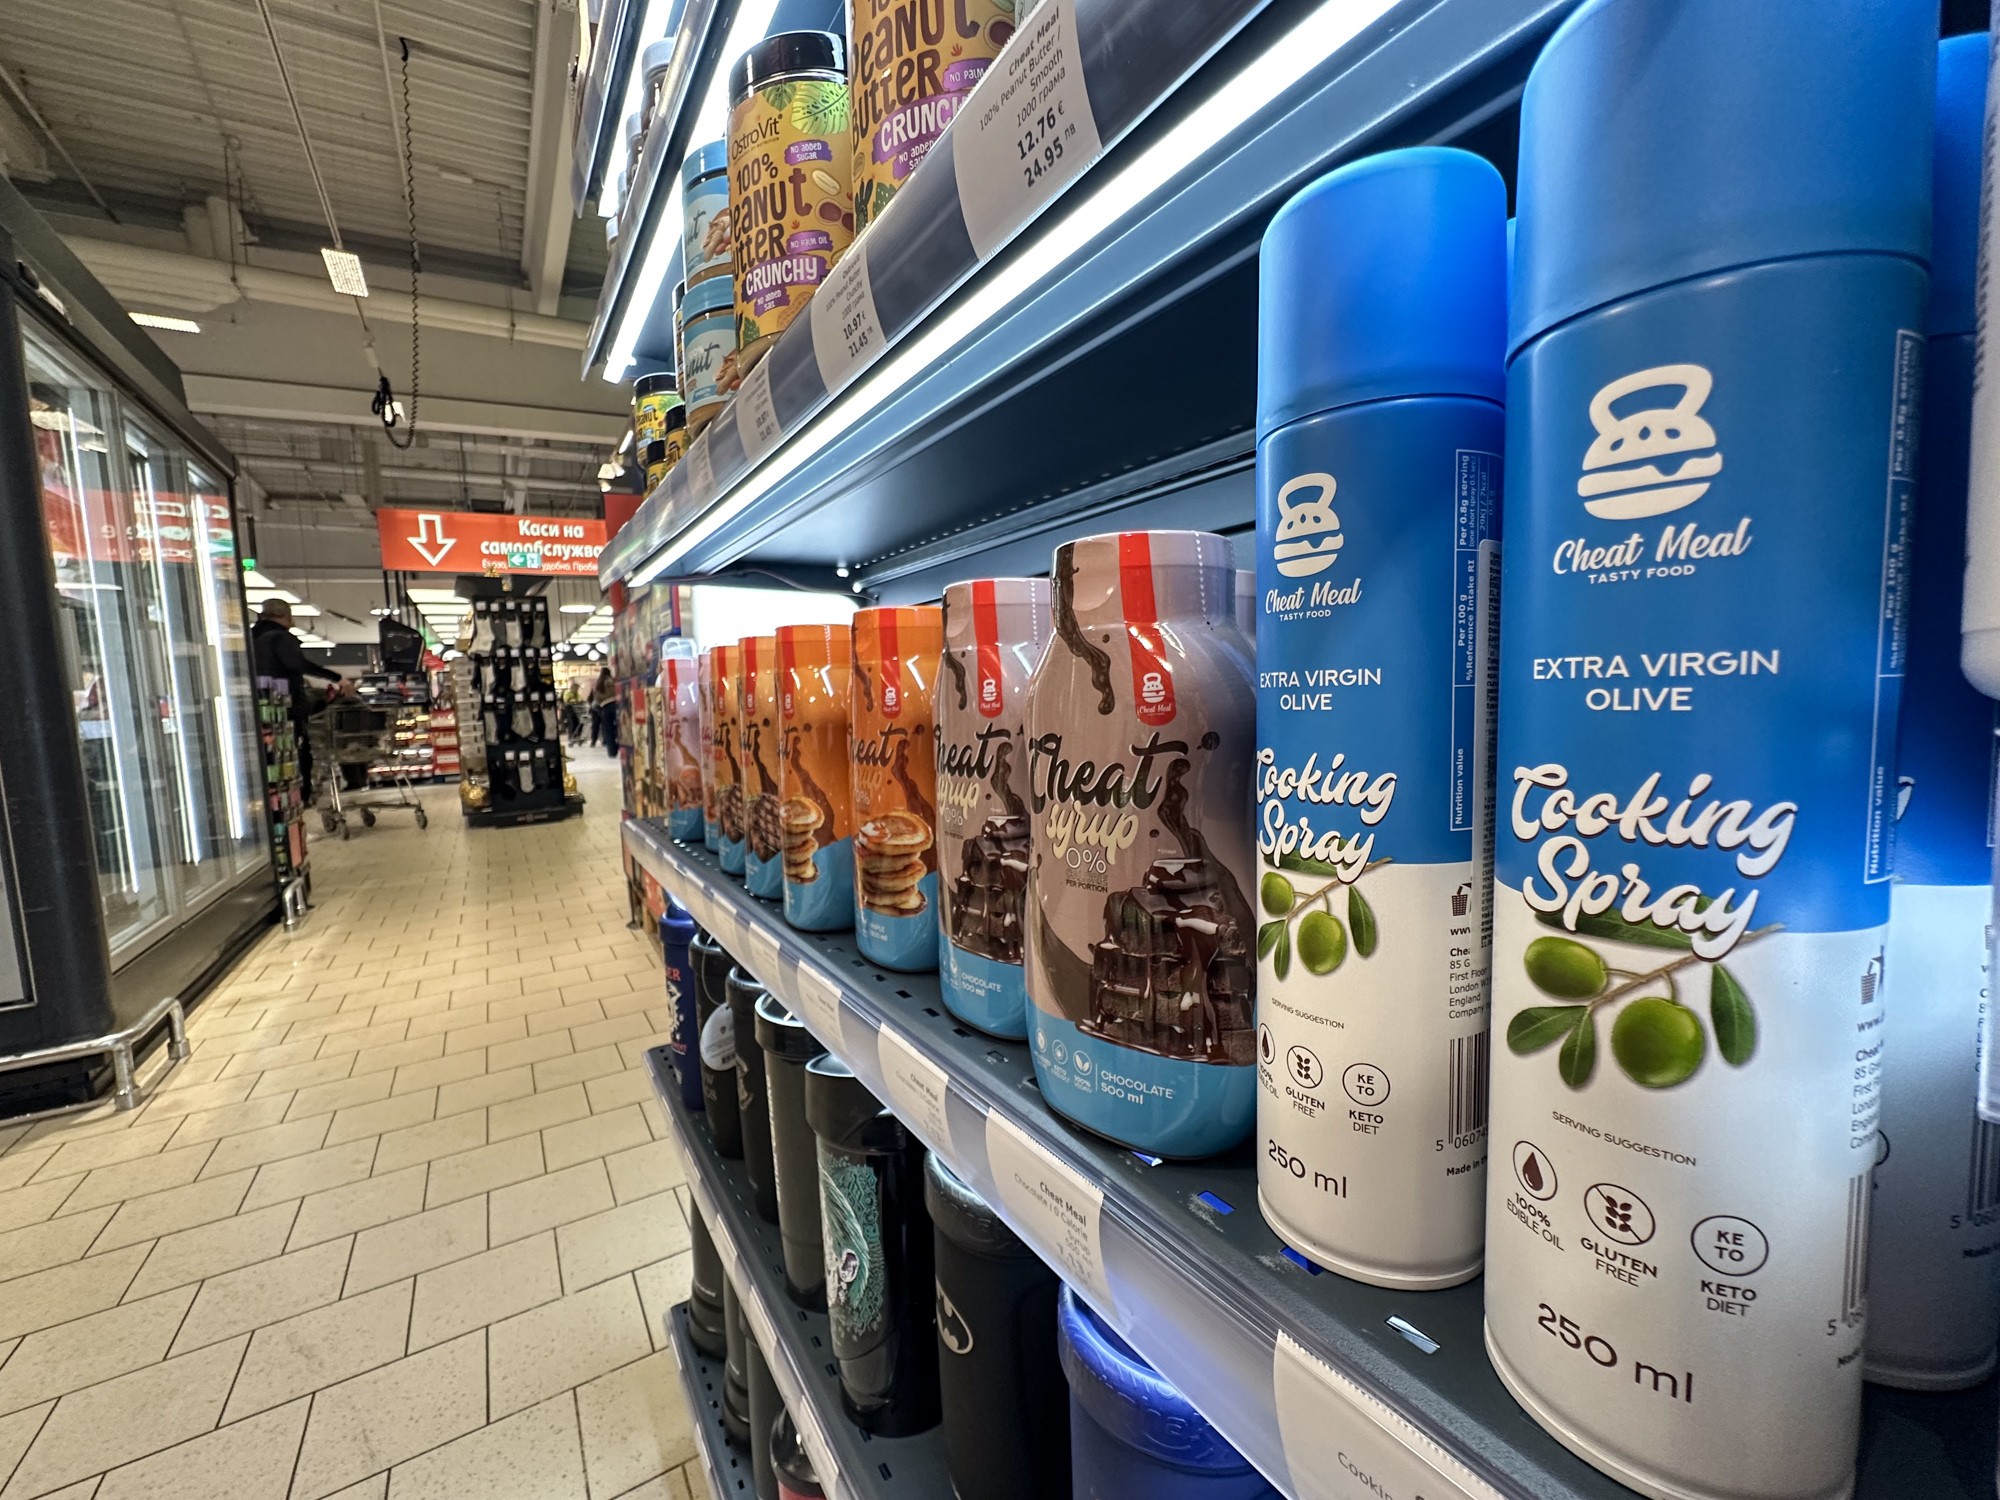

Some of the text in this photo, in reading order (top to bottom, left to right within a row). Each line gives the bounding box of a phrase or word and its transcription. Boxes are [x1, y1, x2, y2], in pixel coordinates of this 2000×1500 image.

[1009, 6, 1060, 76] Cheat Meal
[950, 72, 961, 83] NO
[1030, 48, 1063, 92] Smooth
[979, 100, 1000, 131] 100%
[1000, 68, 1027, 107] Peanut
[1029, 35, 1055, 71] Butter
[1017, 67, 1066, 128] 1000 грама
[1017, 100, 1065, 160] 12.76 €
[790, 145, 799, 153] NO
[899, 151, 908, 163] NO
[1024, 123, 1076, 188] 24.95 лв
[737, 153, 778, 195] 100%
[745, 257, 818, 296] CRUNCHY
[843, 313, 861, 340] 10.97
[849, 331, 868, 357] 21.45
[1461, 455, 1470, 497] serving
[1460, 500, 1469, 524] 0.8g
[519, 519, 584, 538] Каси на
[1553, 517, 1752, 575] Cheat Meal
[1468, 559, 1475, 570] RI
[1588, 564, 1696, 585] TASTY FOOD
[1265, 578, 1362, 614] Cheat Meal
[1460, 594, 1467, 602] g
[1467, 574, 1475, 612] Intake
[1279, 609, 1332, 622] TASTY FOOD
[1533, 649, 1781, 680] EXTRA VIRGIN
[1260, 668, 1381, 688] EXTRA VIRGIN
[1279, 693, 1333, 711] OLIVE
[1585, 687, 1694, 711] OLIVE
[1029, 732, 1189, 814] Cheat
[1256, 747, 1397, 825] Cooking
[1455, 748, 1464, 825] Nutrition value
[1046, 800, 1139, 865] syrup
[1511, 763, 1798, 878] Cooking
[1259, 798, 1375, 884] Spray
[1066, 847, 1107, 874] 0%
[1066, 879, 1108, 893] PER PORTION
[1522, 835, 1760, 962] Spray
[1450, 960, 1461, 969] 85
[1450, 972, 1469, 982] First
[961, 972, 1002, 993] CHOCOLATE
[961, 982, 975, 993] 500
[975, 987, 986, 997] ml
[1449, 983, 1479, 994] London
[1449, 993, 1481, 1007] England
[1449, 1004, 1485, 1019] Company
[1271, 998, 1345, 1029] SERVING SUGGESTION
[1101, 1070, 1174, 1099] CHOCOLATE
[1356, 1085, 1375, 1096] TO
[1357, 1074, 1375, 1085] KE
[1101, 1082, 1144, 1105] 500 ml
[1286, 1086, 1325, 1110] GLUTEN
[1293, 1101, 1315, 1118] FREE
[1349, 1110, 1384, 1124] KETO
[1353, 1122, 1379, 1135] DIET
[1552, 1110, 1697, 1167] SERVING SUGGESTION
[1436, 1139, 1444, 1152] 5
[1268, 1139, 1348, 1199] 250 ml
[1447, 1160, 1480, 1176] Made in
[1039, 1181, 1086, 1227] Cheat Meal
[1515, 1192, 1551, 1228] 100%
[1507, 1198, 1565, 1252] EDIBLE OIL
[1716, 1229, 1745, 1247] KE
[1580, 1237, 1658, 1279] GLUTEN
[1714, 1246, 1745, 1263] TO
[1595, 1258, 1639, 1288] FREE
[1700, 1279, 1757, 1301] KETO
[1706, 1297, 1750, 1317] DIET
[1537, 1302, 1693, 1404] 250 ml
